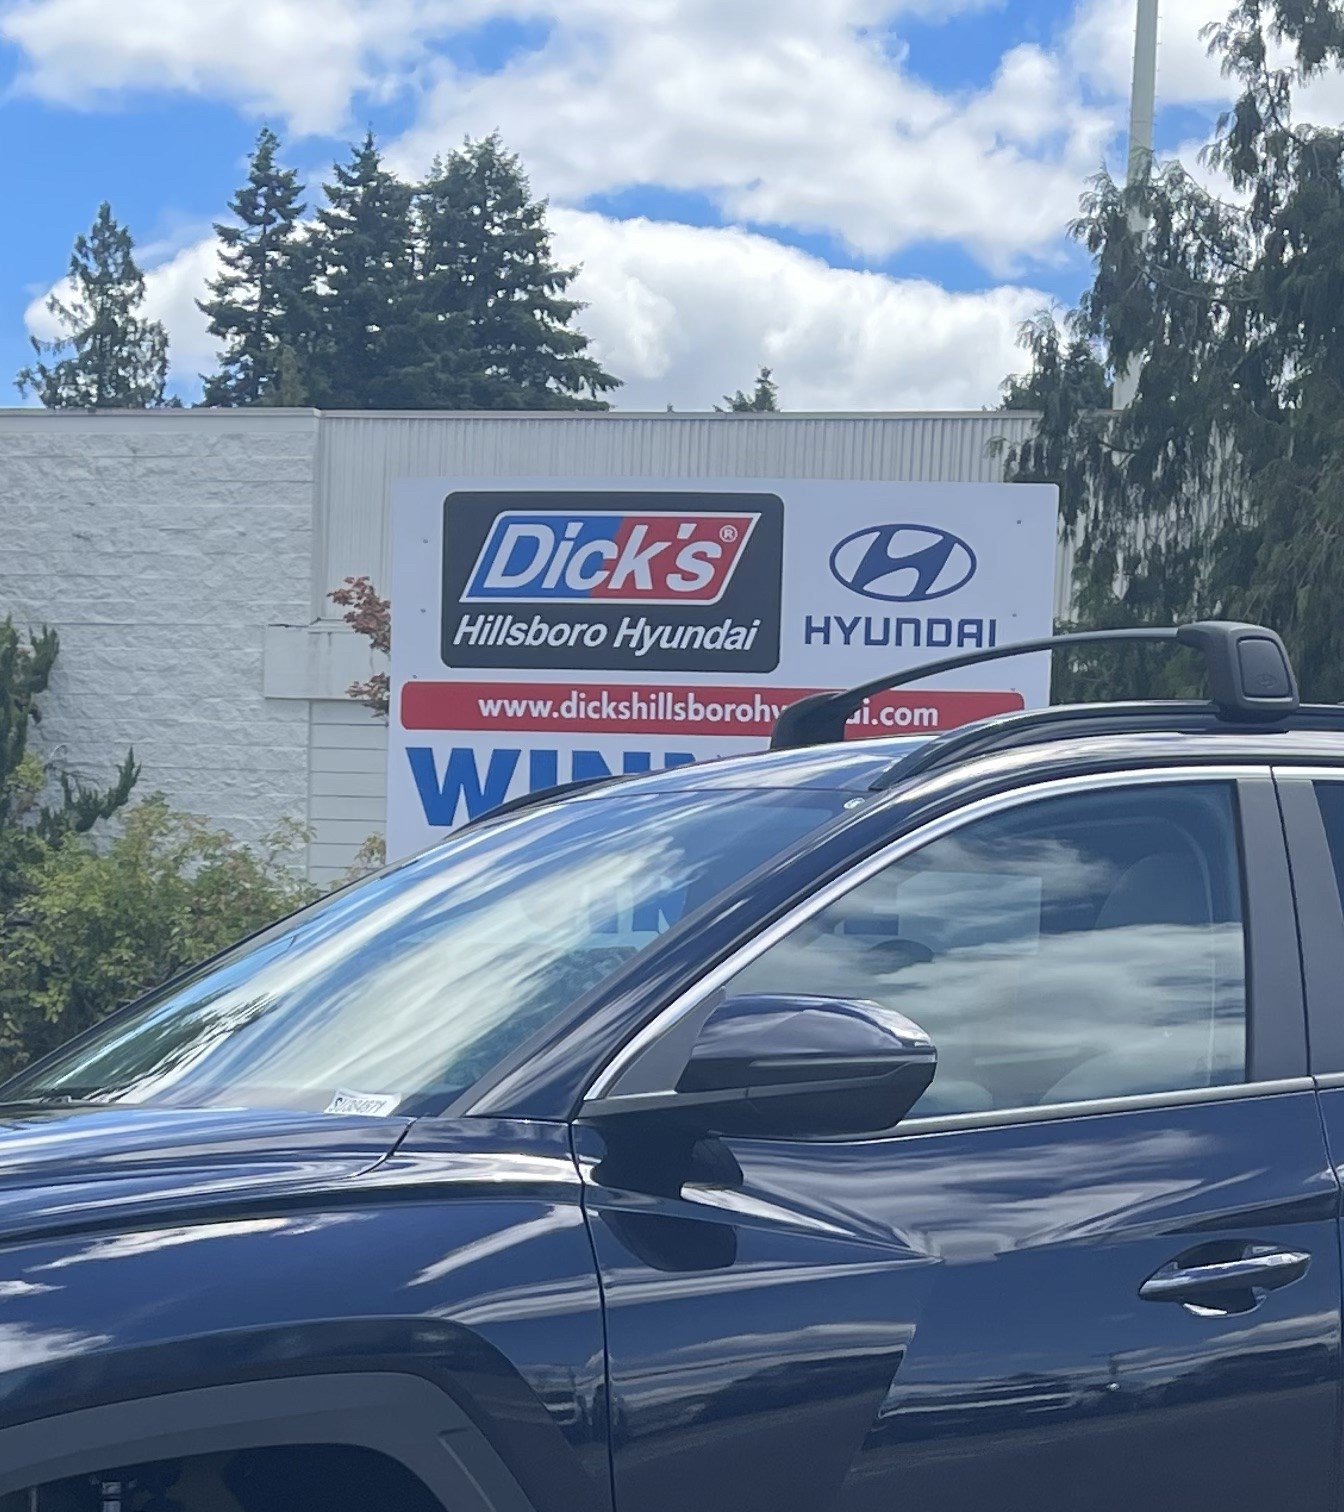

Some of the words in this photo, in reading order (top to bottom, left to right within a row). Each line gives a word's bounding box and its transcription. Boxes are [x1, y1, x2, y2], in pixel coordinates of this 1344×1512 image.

[482, 521, 723, 592] Dick's
[452, 614, 608, 648] Hillsboro
[612, 616, 761, 656] Hyundai
[804, 614, 997, 648] HYUNDAI
[478, 692, 939, 727] www.dickshillsborohi.com
